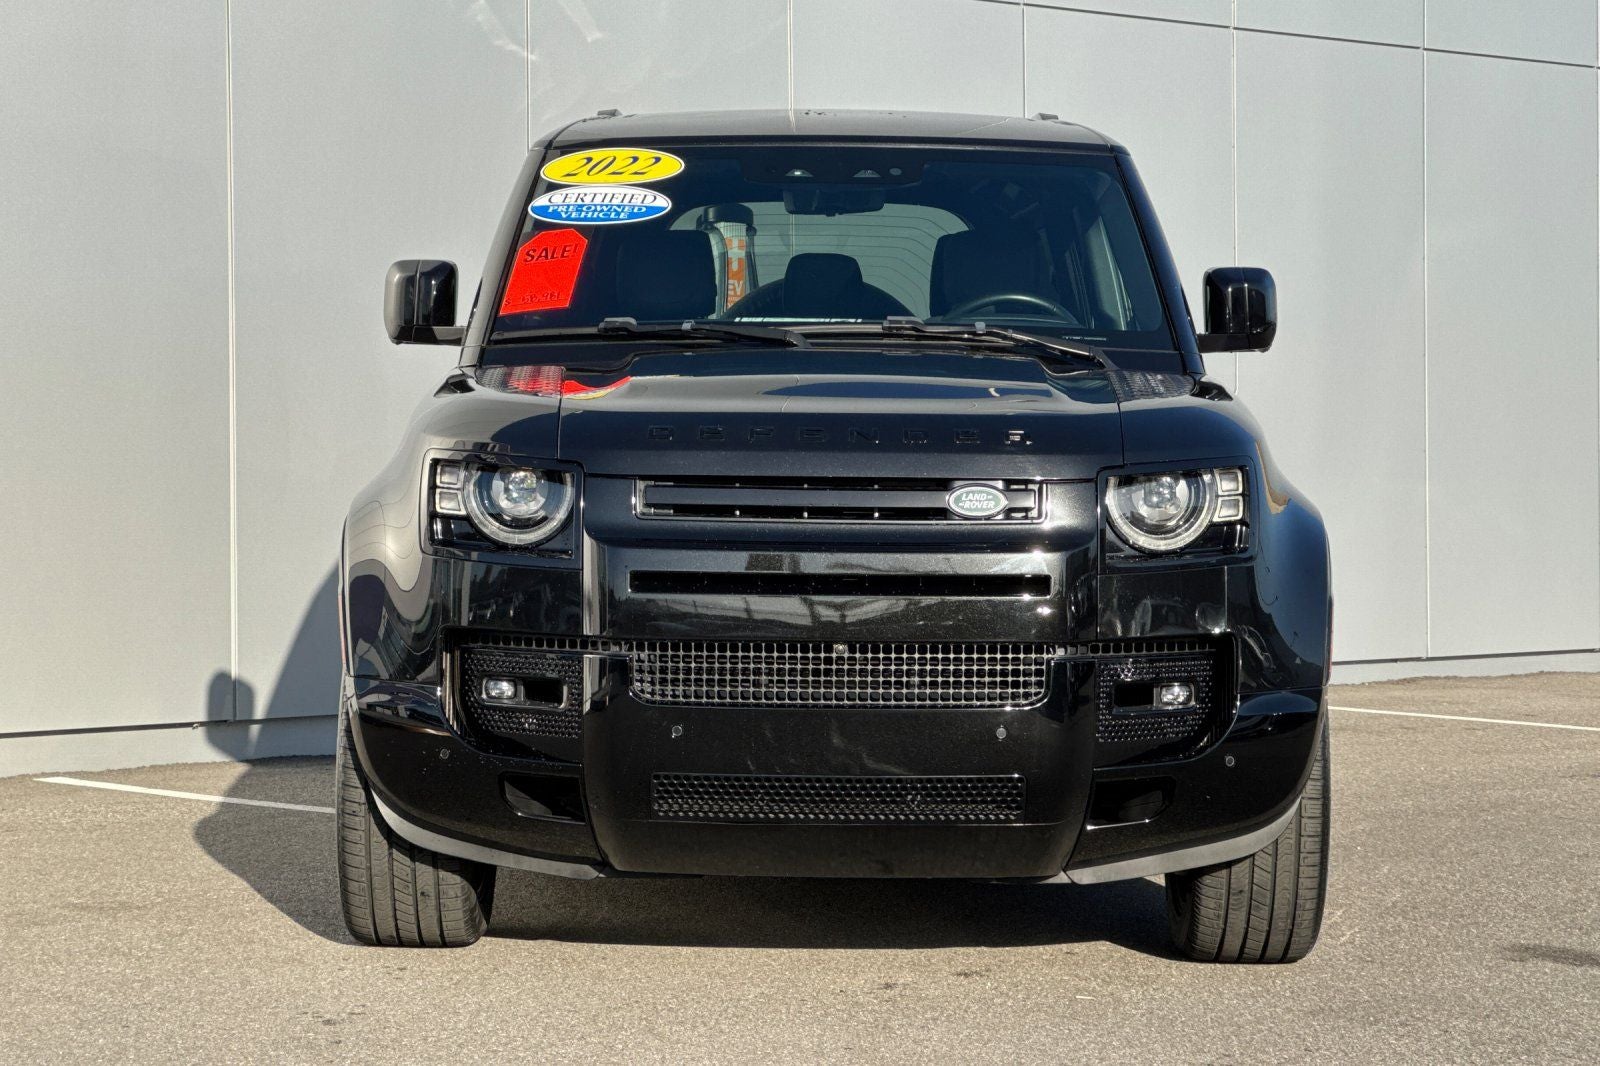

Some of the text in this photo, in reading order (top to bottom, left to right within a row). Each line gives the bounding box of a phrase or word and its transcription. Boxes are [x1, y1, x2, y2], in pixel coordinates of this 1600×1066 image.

[561, 155, 662, 178] 2022
[547, 192, 657, 205] CERTIFIED
[547, 204, 647, 213] PRE-OWNED
[560, 211, 629, 219] VEHICLE
[523, 243, 579, 263] SALE!
